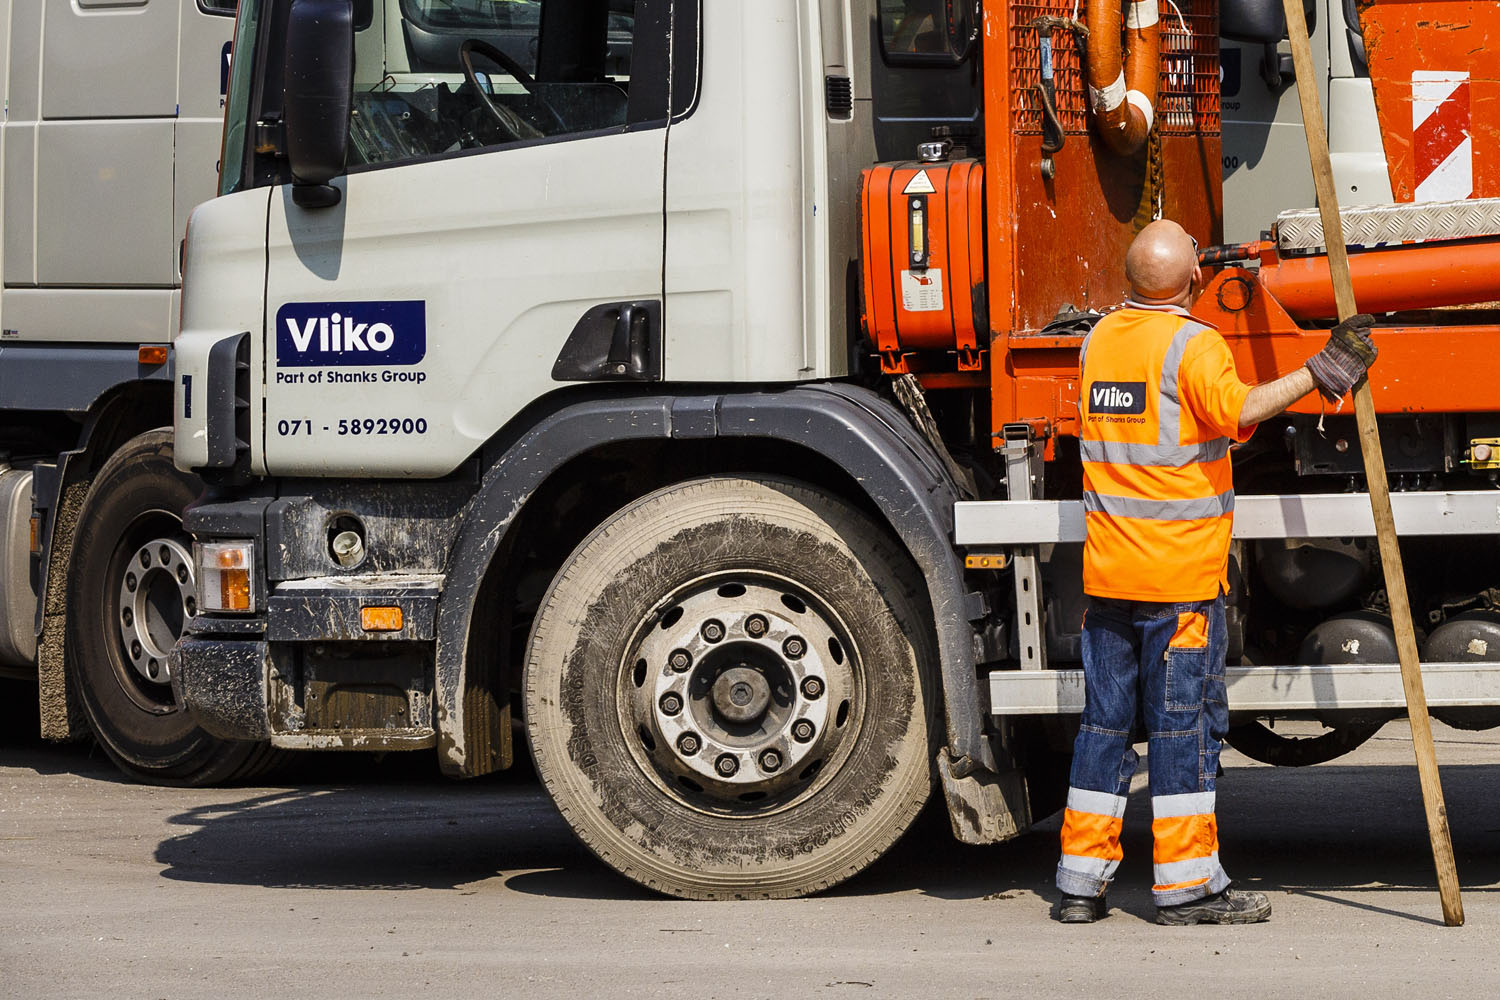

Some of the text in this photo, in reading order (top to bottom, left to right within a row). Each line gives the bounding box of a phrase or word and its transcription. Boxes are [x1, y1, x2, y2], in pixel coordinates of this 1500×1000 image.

[286, 312, 394, 352] Vliko
[277, 370, 426, 384] Part of Shanks Group
[1093, 386, 1133, 408] Vliko
[278, 420, 312, 435] 071
[338, 418, 427, 435] 5892900
